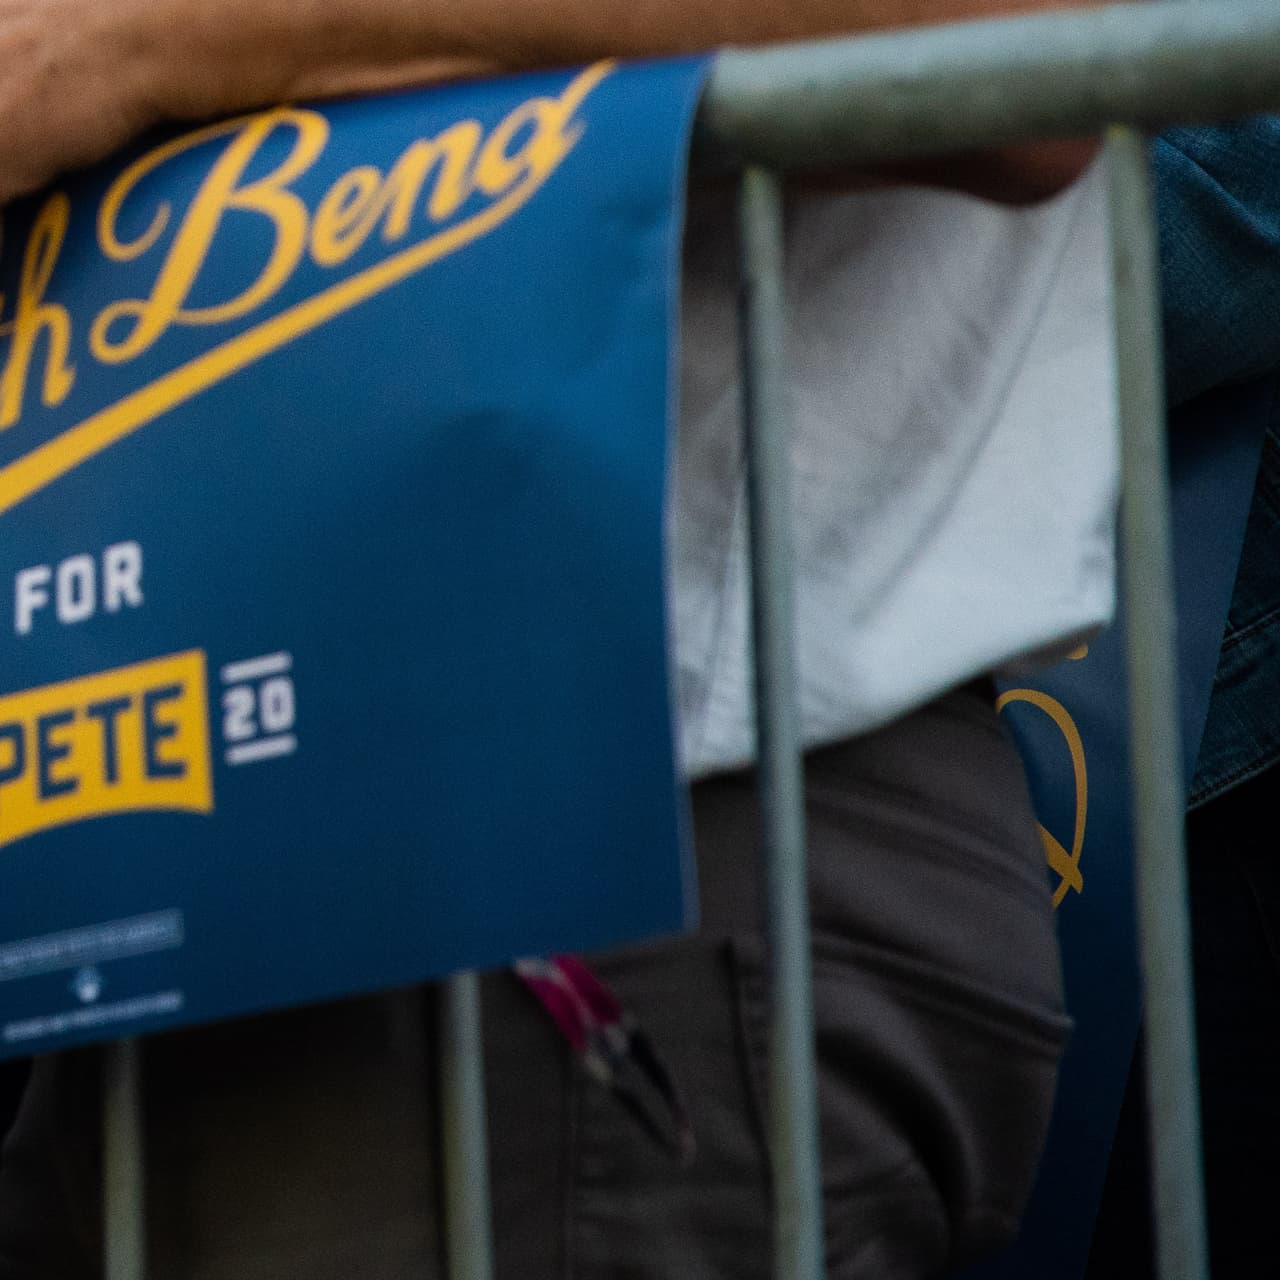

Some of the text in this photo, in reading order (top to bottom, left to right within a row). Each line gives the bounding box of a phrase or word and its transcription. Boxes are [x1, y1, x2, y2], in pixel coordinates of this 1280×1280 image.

[89, 57, 618, 364] Bend
[14, 540, 144, 636] FOR
[222, 676, 296, 742] 20
